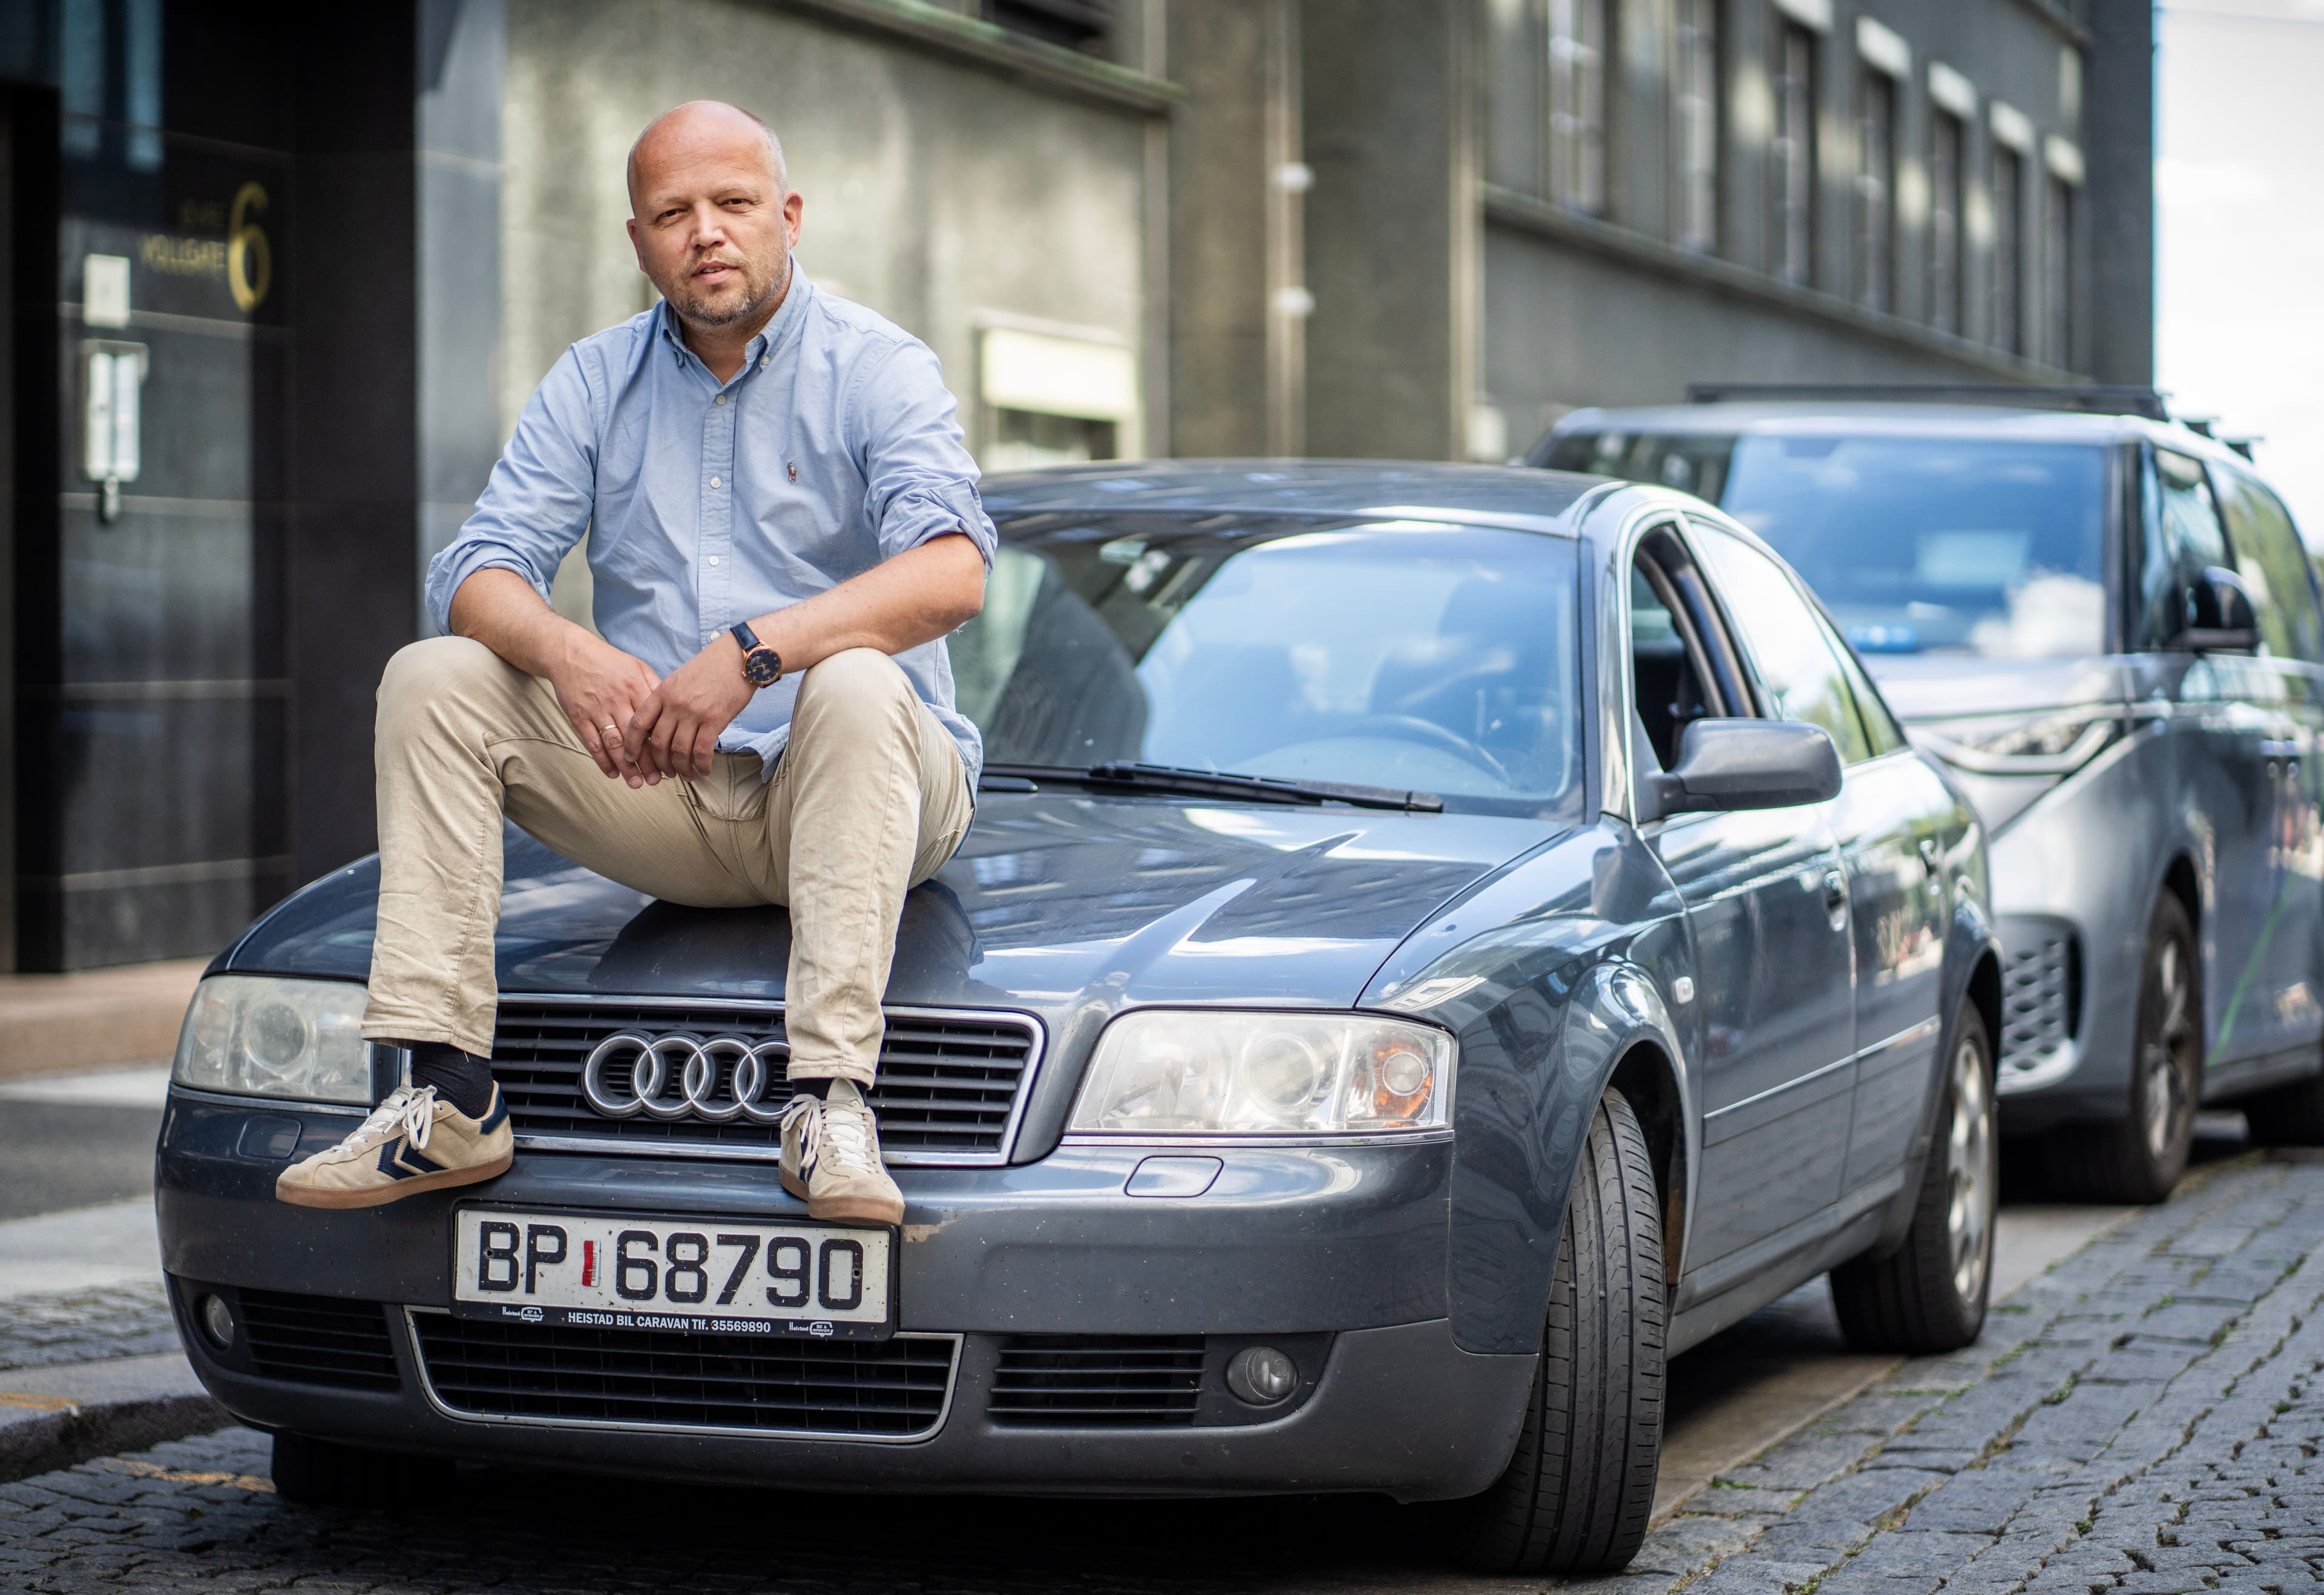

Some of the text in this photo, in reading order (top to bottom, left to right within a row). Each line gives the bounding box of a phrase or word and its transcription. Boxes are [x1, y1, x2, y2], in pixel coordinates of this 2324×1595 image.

[228, 181, 271, 312] 6
[479, 1220, 864, 1311] BP 68790
[568, 1312, 771, 1333] HEISTAD BIL CARAVAN Tlf. 35569890
[789, 1321, 809, 1331] Heistad
